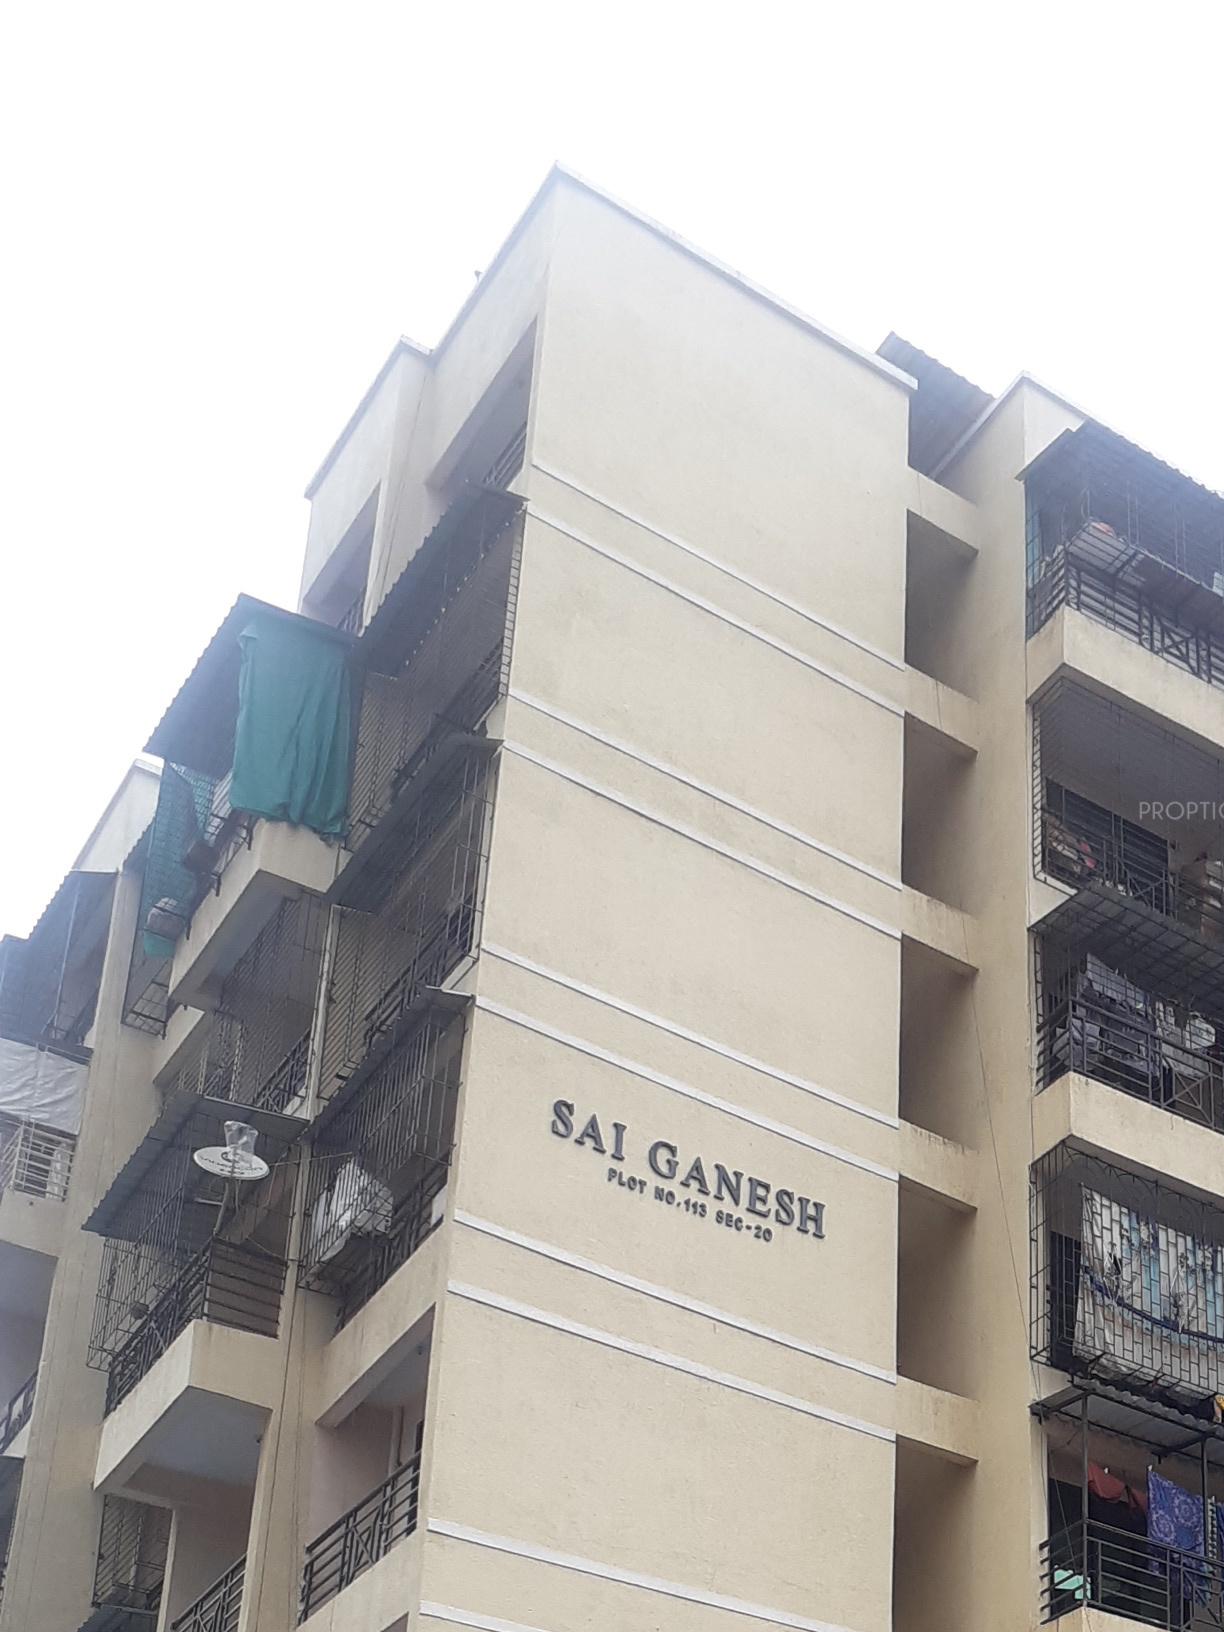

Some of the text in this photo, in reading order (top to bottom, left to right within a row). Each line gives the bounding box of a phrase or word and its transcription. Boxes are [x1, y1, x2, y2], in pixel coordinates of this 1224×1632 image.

[551, 1099, 827, 1239] SAI GANESH
[607, 1167, 648, 1195] PLOT
[715, 1210, 774, 1243] SEC-20
